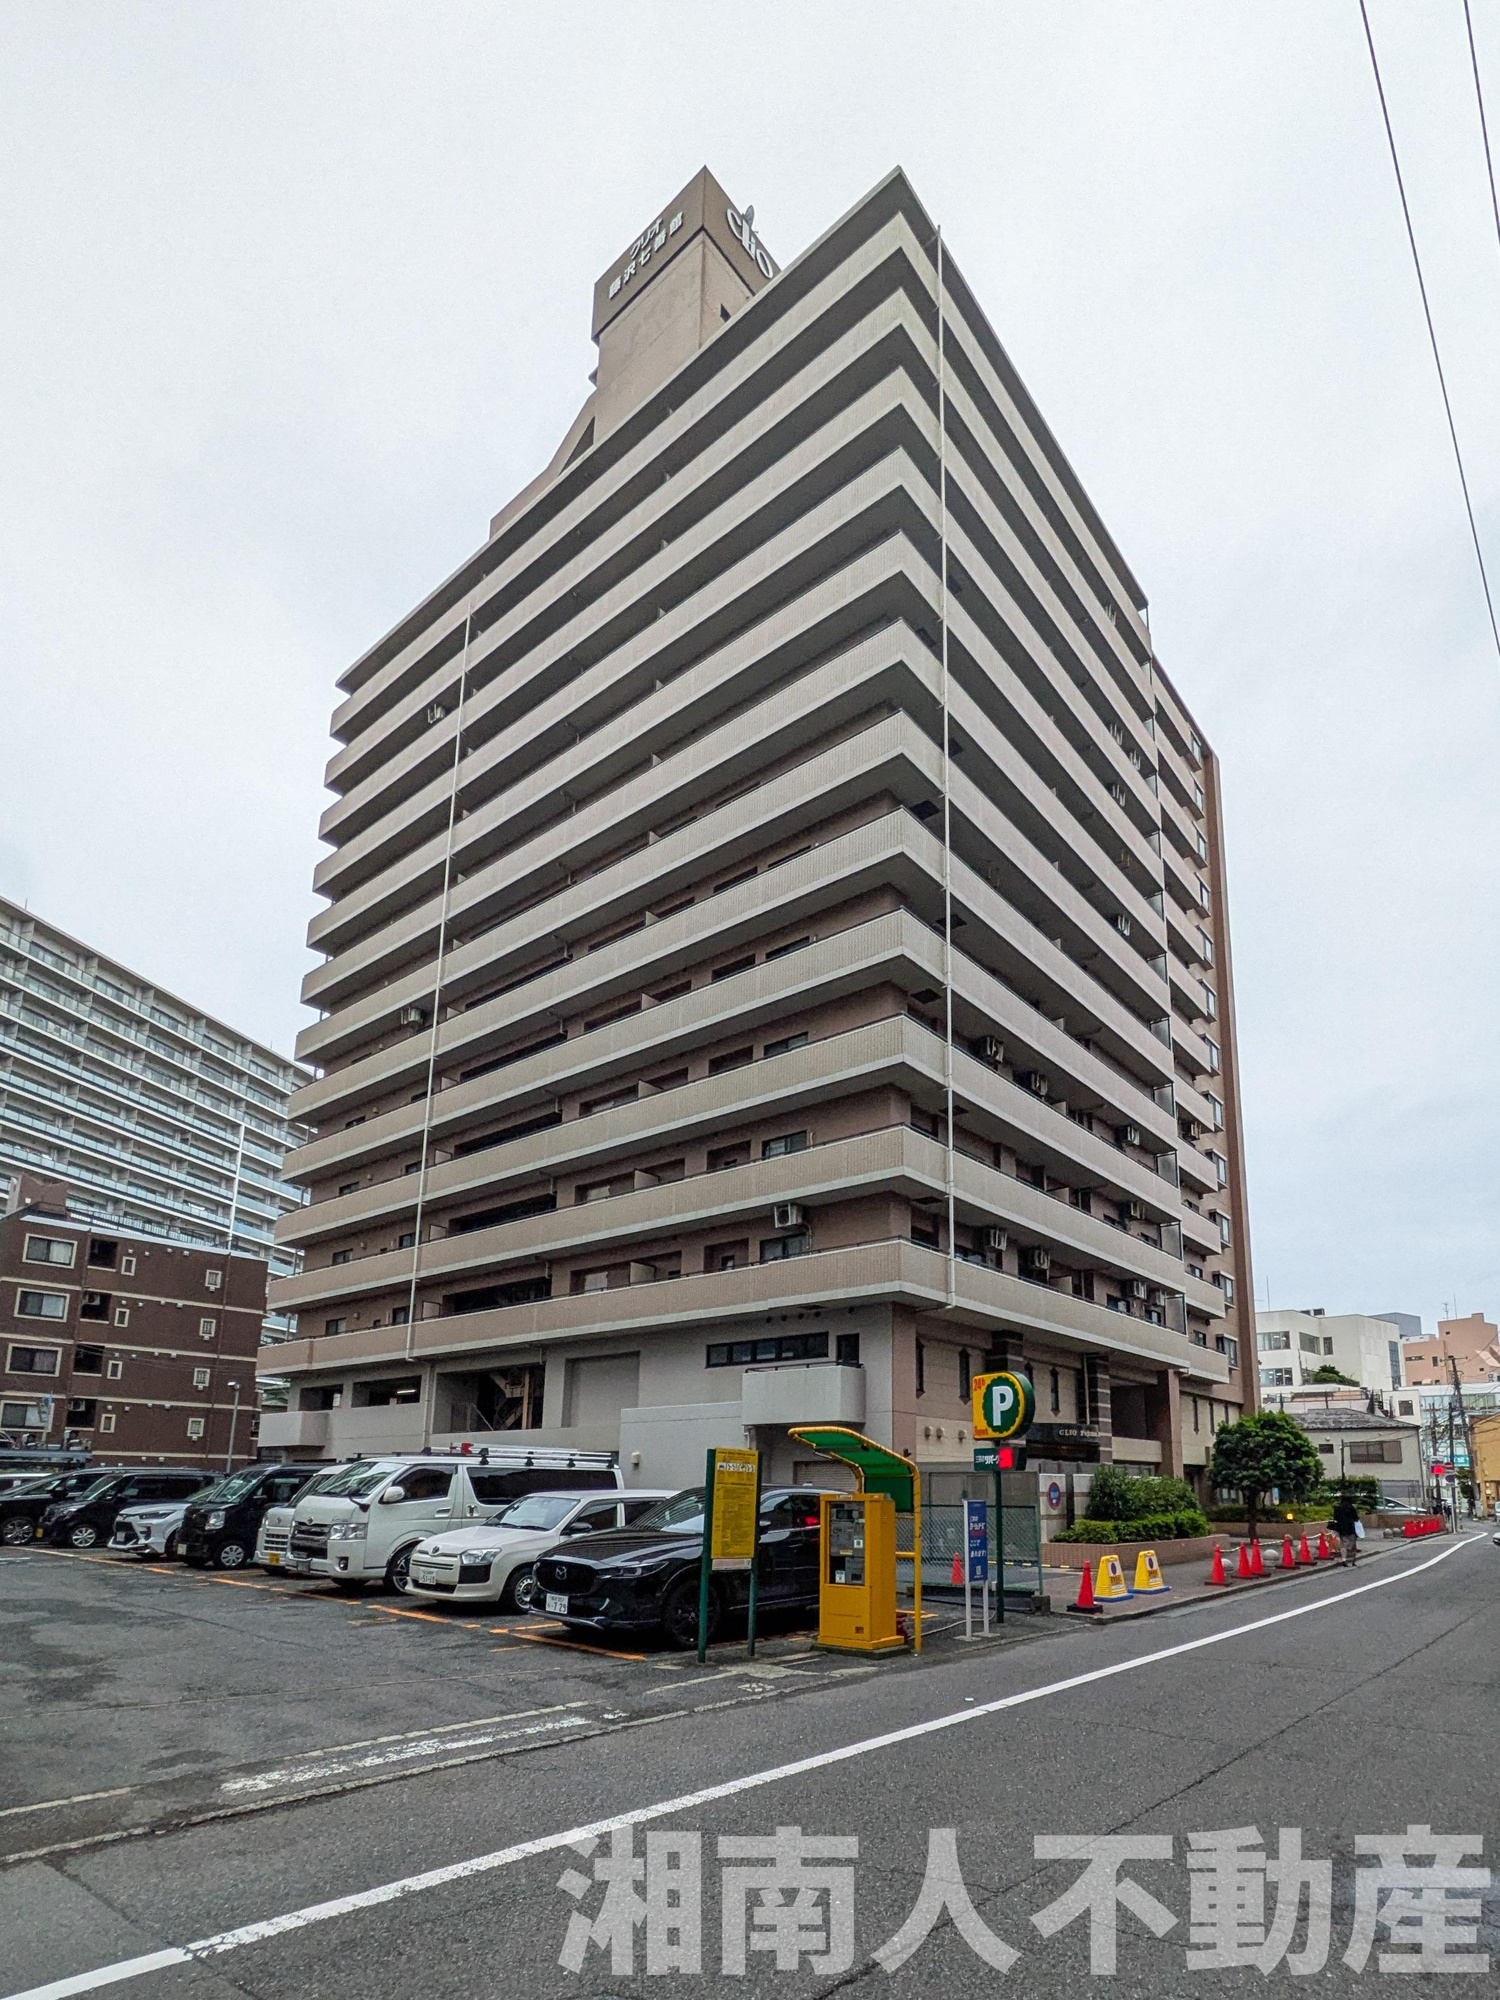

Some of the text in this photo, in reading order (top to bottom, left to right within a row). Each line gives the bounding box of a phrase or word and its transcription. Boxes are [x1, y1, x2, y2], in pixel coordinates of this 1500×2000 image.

[630, 218, 663, 260] クリオ
[992, 1385, 1014, 1426] P
